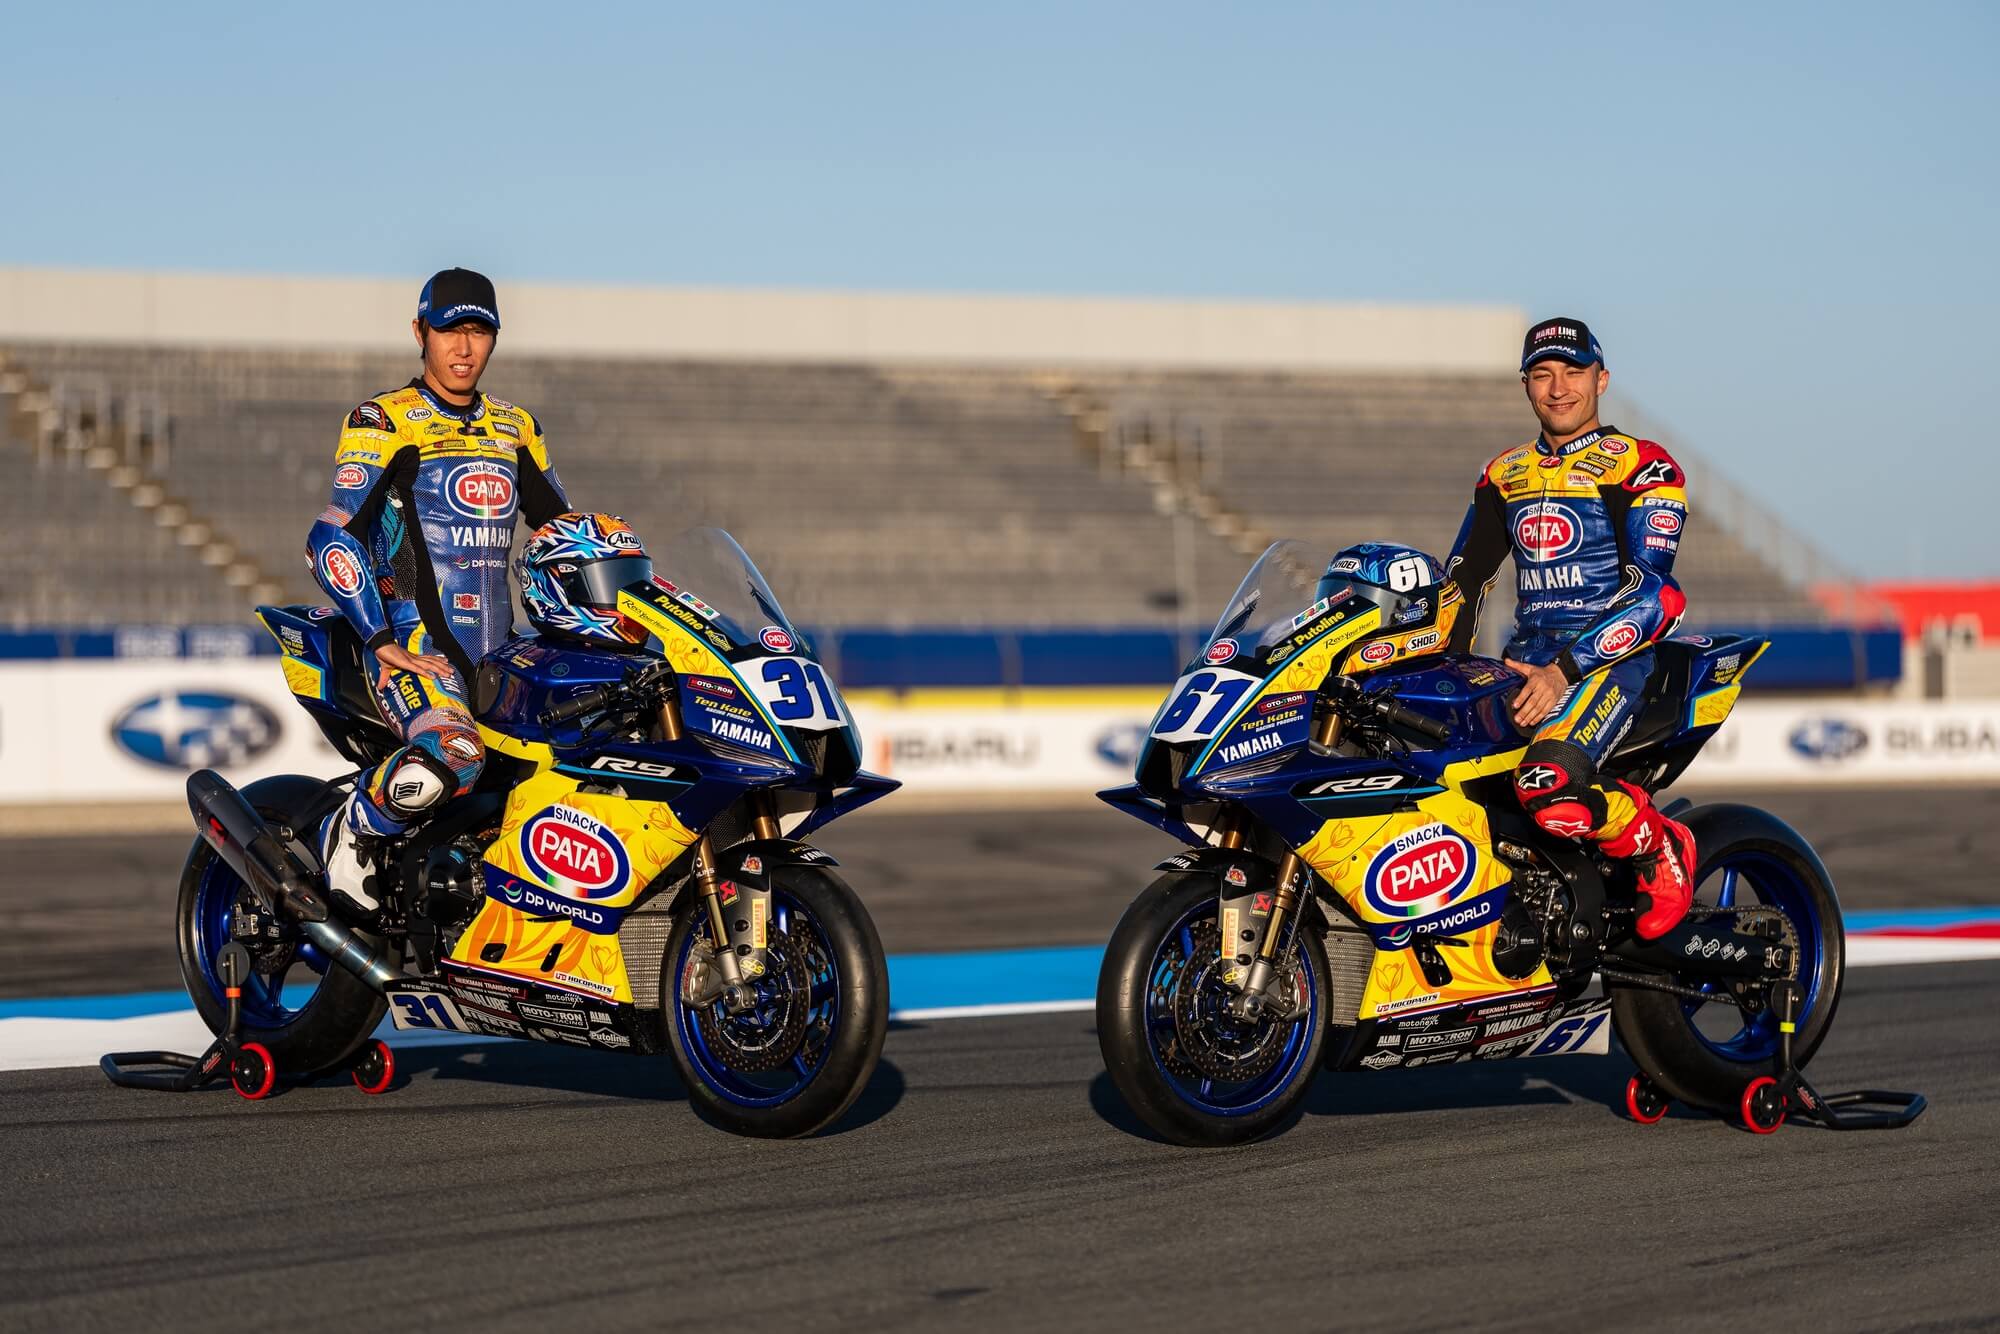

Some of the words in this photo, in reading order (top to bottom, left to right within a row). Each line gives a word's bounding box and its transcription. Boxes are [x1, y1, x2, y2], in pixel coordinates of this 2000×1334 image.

[1535, 327, 1556, 340] HARD
[1558, 326, 1577, 337] LINE
[1564, 432, 1601, 454] YAMAHA
[338, 472, 360, 481] PATA
[465, 480, 506, 500] PATA
[1522, 522, 1564, 543] PATA
[1654, 517, 1676, 527] PATA
[451, 526, 512, 549] YAMAHA
[614, 533, 639, 545] Arai
[1646, 536, 1666, 547] HARD
[329, 554, 356, 586] PATA
[471, 559, 486, 569] DP
[1333, 559, 1357, 570] SHOEI
[1388, 556, 1432, 593] 61
[654, 595, 704, 630] Putoline
[767, 633, 790, 645] PATA
[1294, 611, 1345, 646] Putoline
[1210, 647, 1229, 656] PATA
[1411, 633, 1437, 649] SHOEI
[1604, 630, 1633, 651] PATA
[1367, 647, 1389, 658] PATA
[396, 674, 422, 710] Kate
[762, 658, 841, 721] 31
[694, 695, 719, 707] Ten
[721, 702, 752, 717] Kate
[1154, 672, 1255, 735] 61
[1240, 720, 1264, 732] Ten
[1267, 710, 1298, 724] Kate
[1574, 718, 1600, 746] Ten
[1595, 685, 1621, 721] Kate
[711, 718, 772, 749] YAMAHA
[1218, 732, 1283, 763] YAMAHA
[589, 756, 677, 778] R9
[1308, 775, 1404, 794] R9
[555, 806, 600, 836] SNACK
[1396, 826, 1442, 853] SNACK
[539, 827, 602, 878] PATA
[1390, 852, 1457, 895] PATA
[525, 891, 545, 907] DP
[546, 900, 604, 925] WORLD
[1416, 919, 1440, 934] DP
[1439, 902, 1491, 929] WORLD
[755, 903, 764, 944] PIRELLI
[1225, 911, 1236, 956] PIRELLI
[392, 994, 459, 1031] 31
[521, 1006, 583, 1022] MOTO-TRON
[1484, 1009, 1551, 1037] YAMALUBE
[1398, 1017, 1440, 1031] motonext
[1528, 1012, 1610, 1056] 61
[1378, 1034, 1401, 1046] ALMA
[1409, 1030, 1473, 1046] MOTO-TRON
